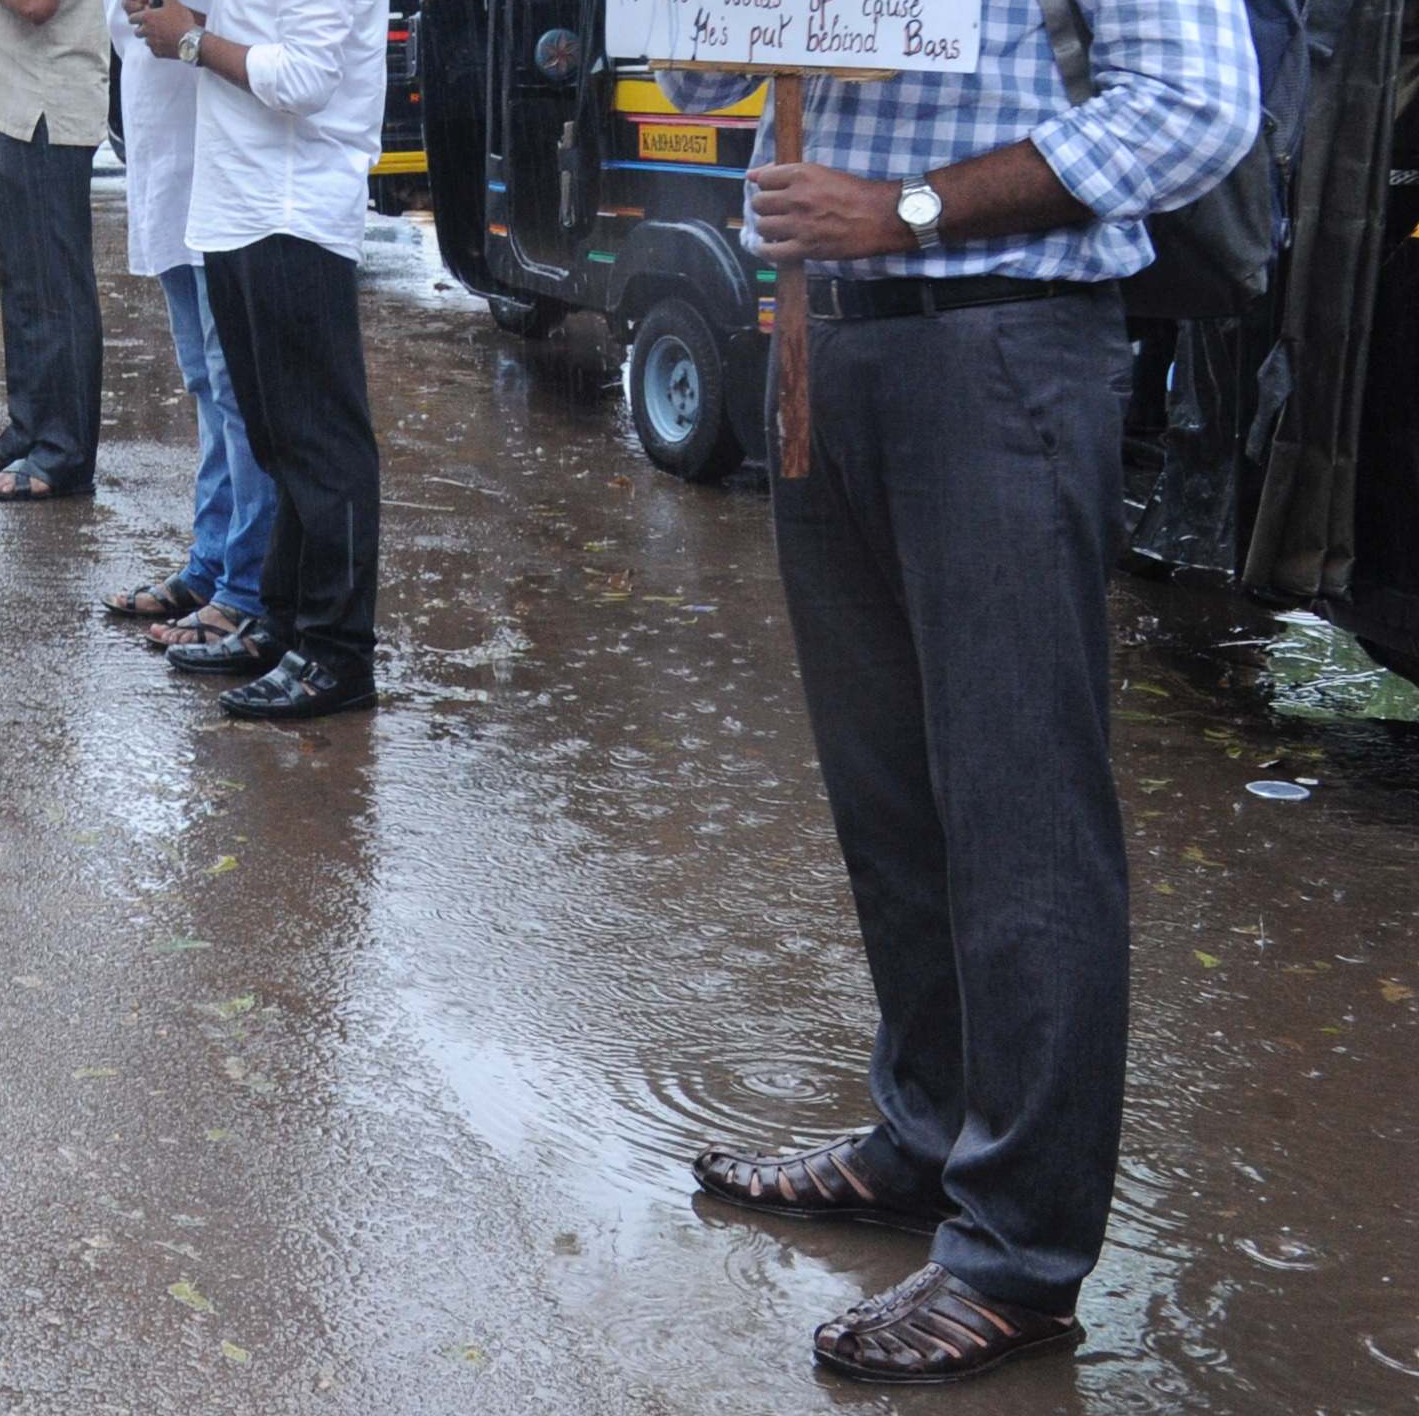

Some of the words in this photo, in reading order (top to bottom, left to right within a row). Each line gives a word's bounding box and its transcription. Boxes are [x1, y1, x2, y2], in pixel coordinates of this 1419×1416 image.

[749, 14, 792, 61] put
[806, 13, 878, 54] behind
[903, 19, 960, 60] Bars
